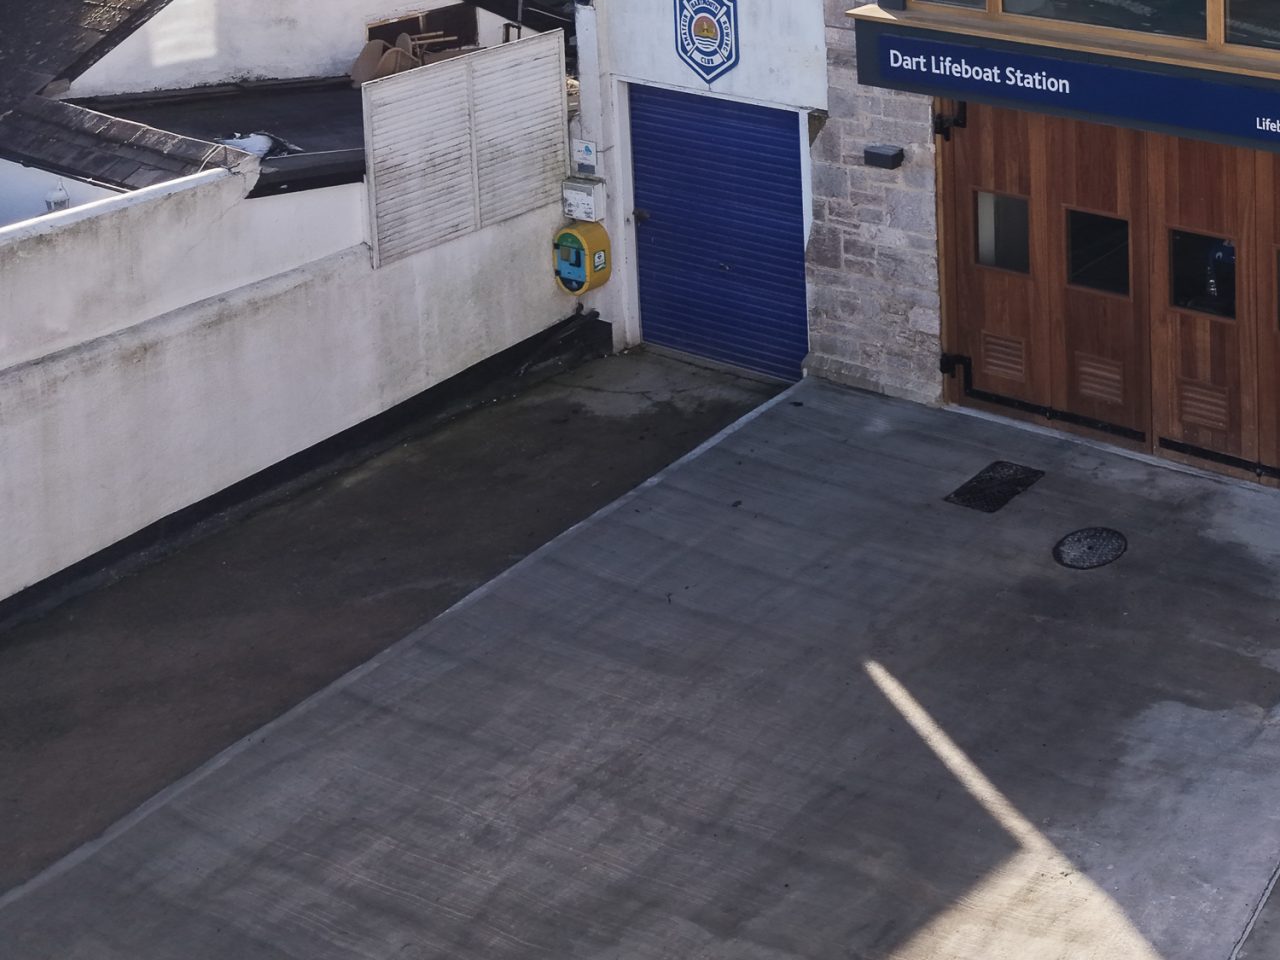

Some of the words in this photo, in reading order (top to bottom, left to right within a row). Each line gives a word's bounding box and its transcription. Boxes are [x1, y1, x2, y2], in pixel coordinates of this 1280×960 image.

[681, 14, 691, 47] AMATEUR
[722, 20, 731, 52] ROWING
[700, 56, 715, 65] CLUB
[889, 49, 927, 72] Dart
[931, 55, 1001, 83] Lifeboat
[1005, 66, 1070, 93] Station
